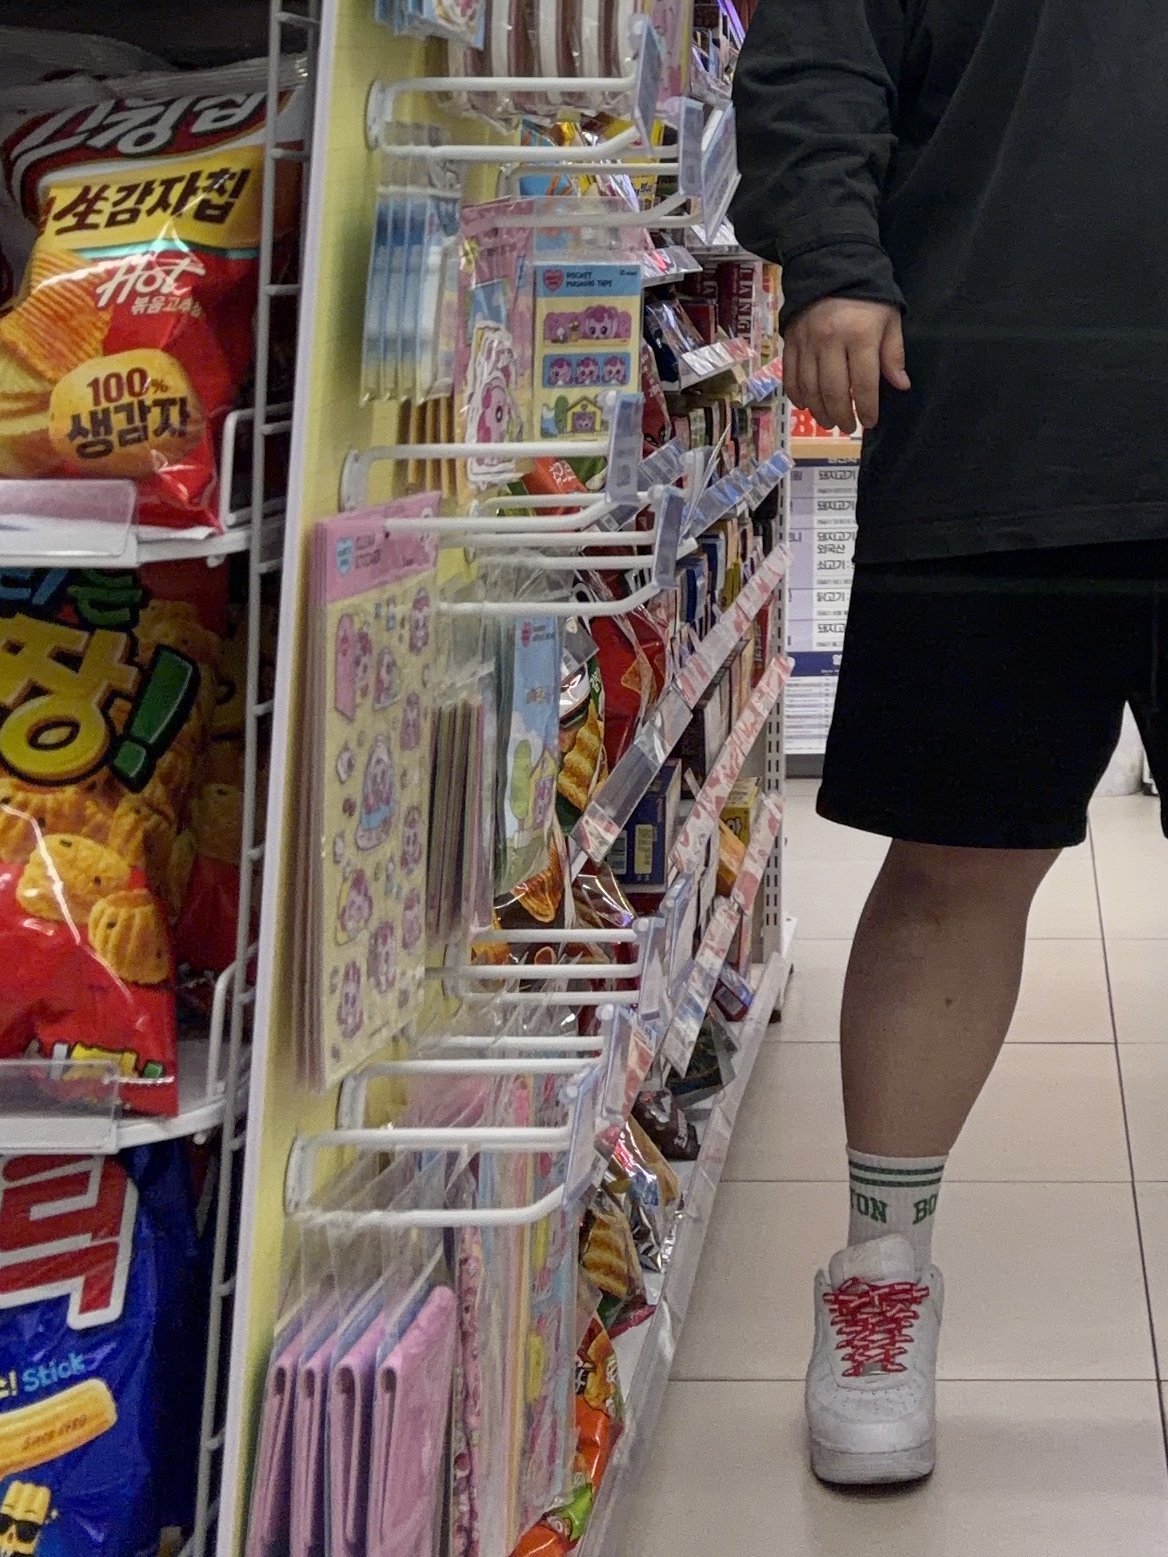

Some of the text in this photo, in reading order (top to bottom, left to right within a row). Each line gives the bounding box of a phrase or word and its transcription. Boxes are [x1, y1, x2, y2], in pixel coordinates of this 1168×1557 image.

[96, 251, 207, 309] Hot
[67, 396, 191, 461] 생감자
[850, 1188, 888, 1224] TON
[22, 1350, 86, 1393] Stick
